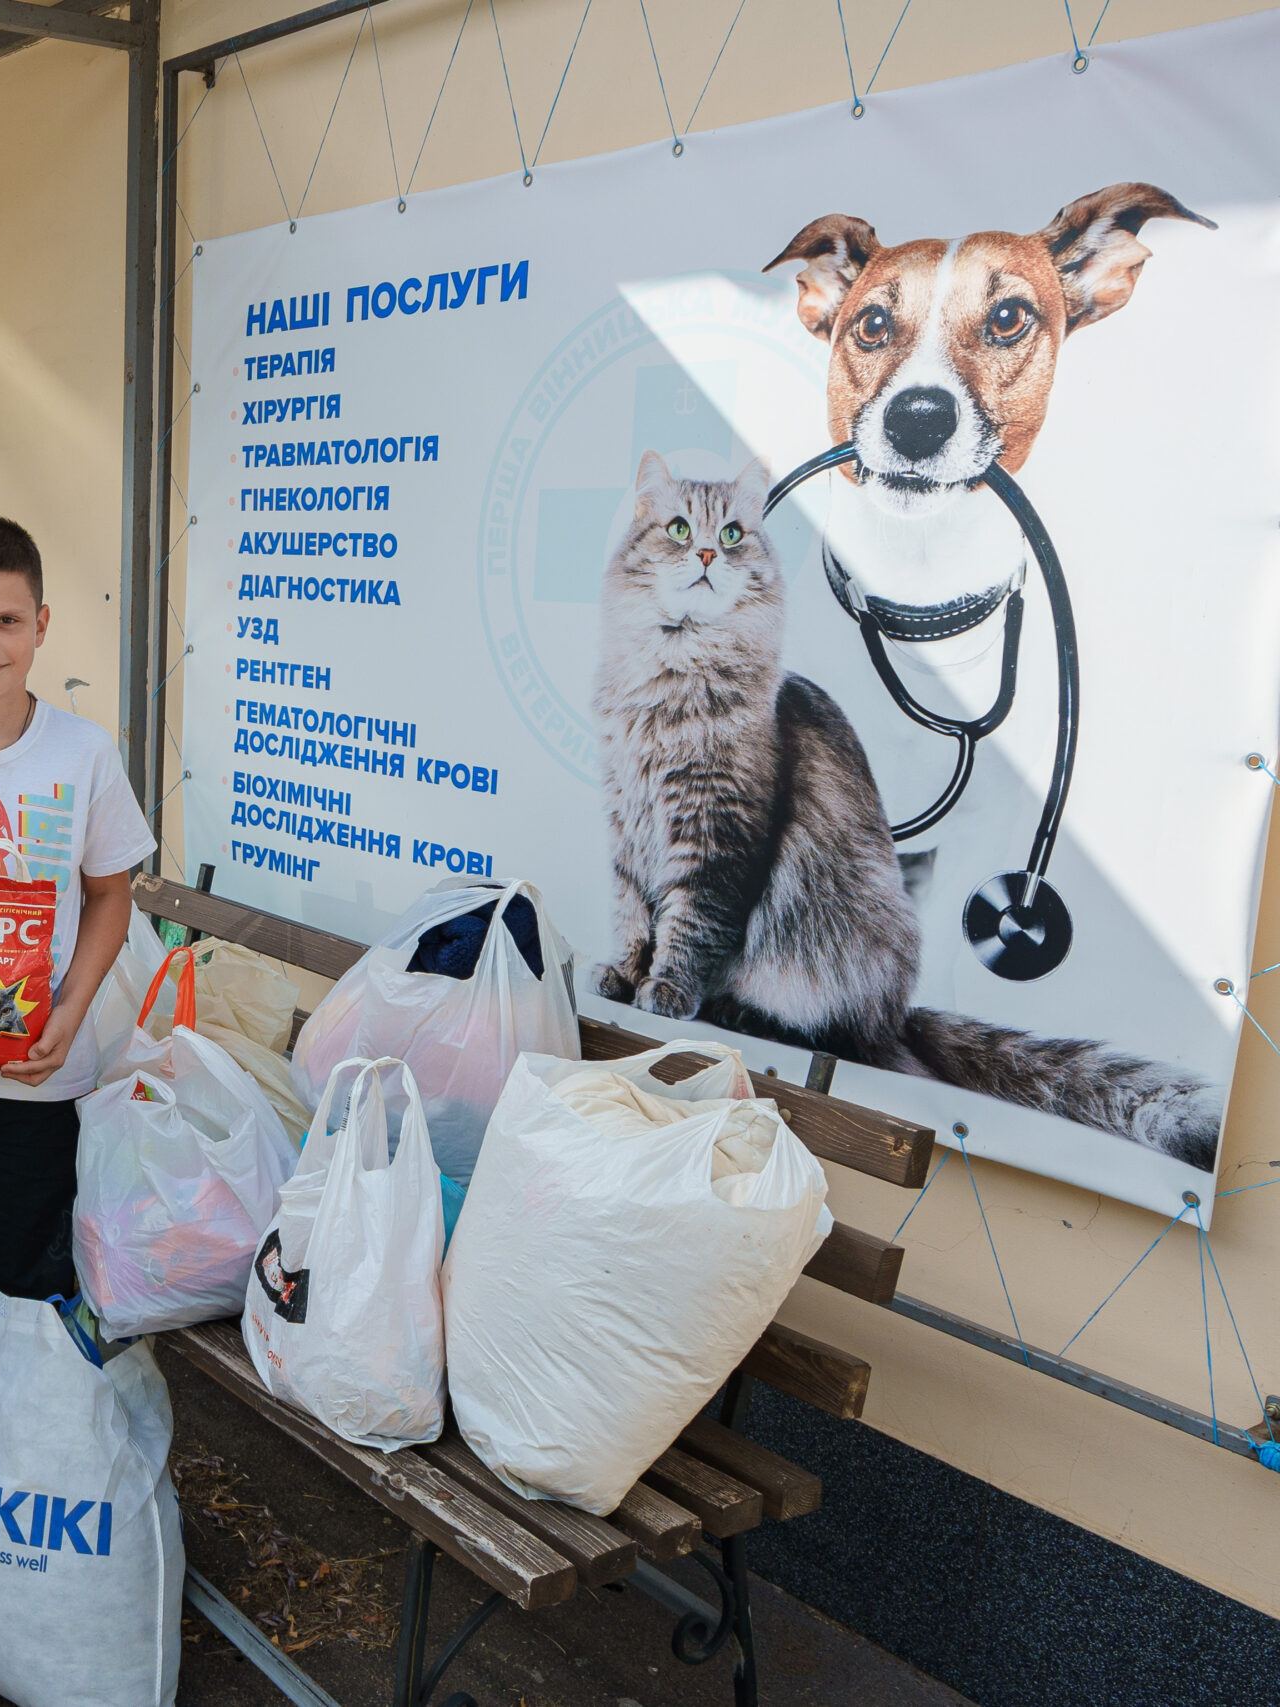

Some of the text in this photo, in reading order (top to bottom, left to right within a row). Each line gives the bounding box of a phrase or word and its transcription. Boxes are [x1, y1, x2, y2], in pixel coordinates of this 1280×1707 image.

[246, 259, 530, 337] НАШІ ПОСЛУГИ
[244, 347, 336, 381] ТЕРАПІЯ
[242, 393, 342, 425] ХІРУРГІЯ
[241, 434, 440, 468] ТРАВМАТОЛОГІЯ
[240, 485, 391, 512] ГІНЕКОЛОГІЯ
[487, 437, 533, 576] ПЕРША
[238, 531, 399, 559] АКУШЕРСТВО
[238, 574, 402, 606] ДІАГНОСТИКА
[236, 615, 280, 645] УЗД
[235, 657, 332, 690] РЕНТГЕН
[235, 699, 417, 749] ГЕМАТОЛОГІЧНІ
[233, 728, 499, 796] ДОСЛІДЖЕННЯ КРОВІ
[232, 770, 352, 817] БІОХІМІЧНІ
[231, 800, 494, 879] ДОСЛІДЖЕННЯ КРОВІ
[231, 839, 321, 882] ГРУМІНГ
[0, 908, 43, 916] ГІГІЄНІЧНИЙ
[15, 1554, 48, 1573] well
